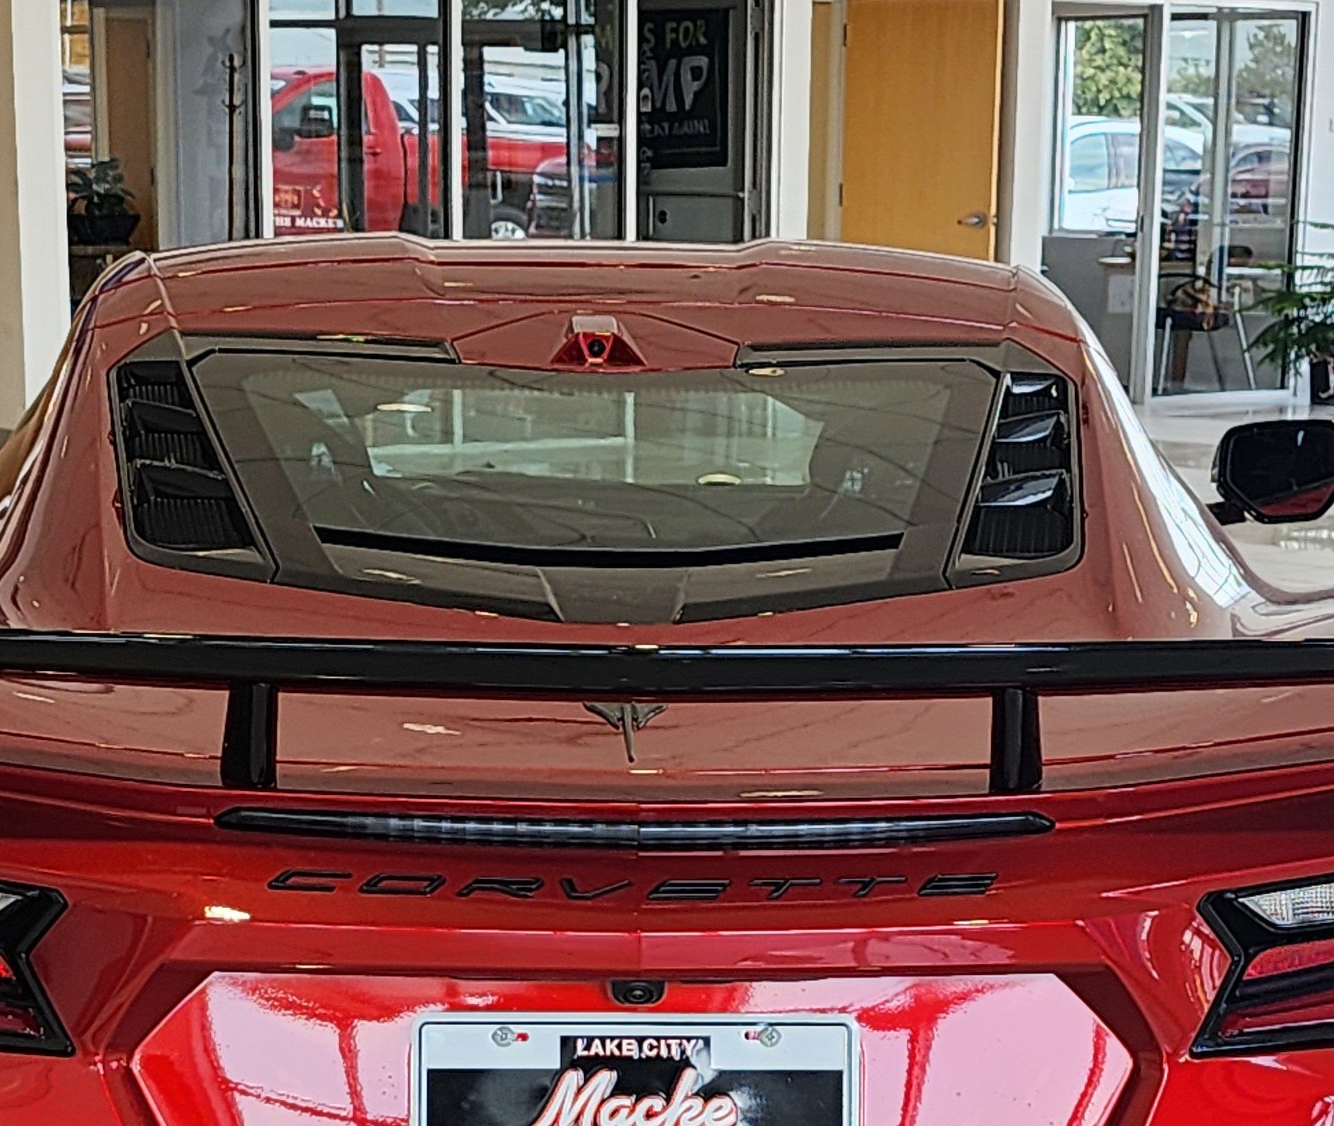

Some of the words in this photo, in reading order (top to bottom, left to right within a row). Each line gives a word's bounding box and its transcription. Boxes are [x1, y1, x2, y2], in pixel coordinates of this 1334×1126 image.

[266, 868, 998, 902] CORVETTE
[575, 1038, 637, 1058] LAKE
[643, 1038, 697, 1058] CITY
